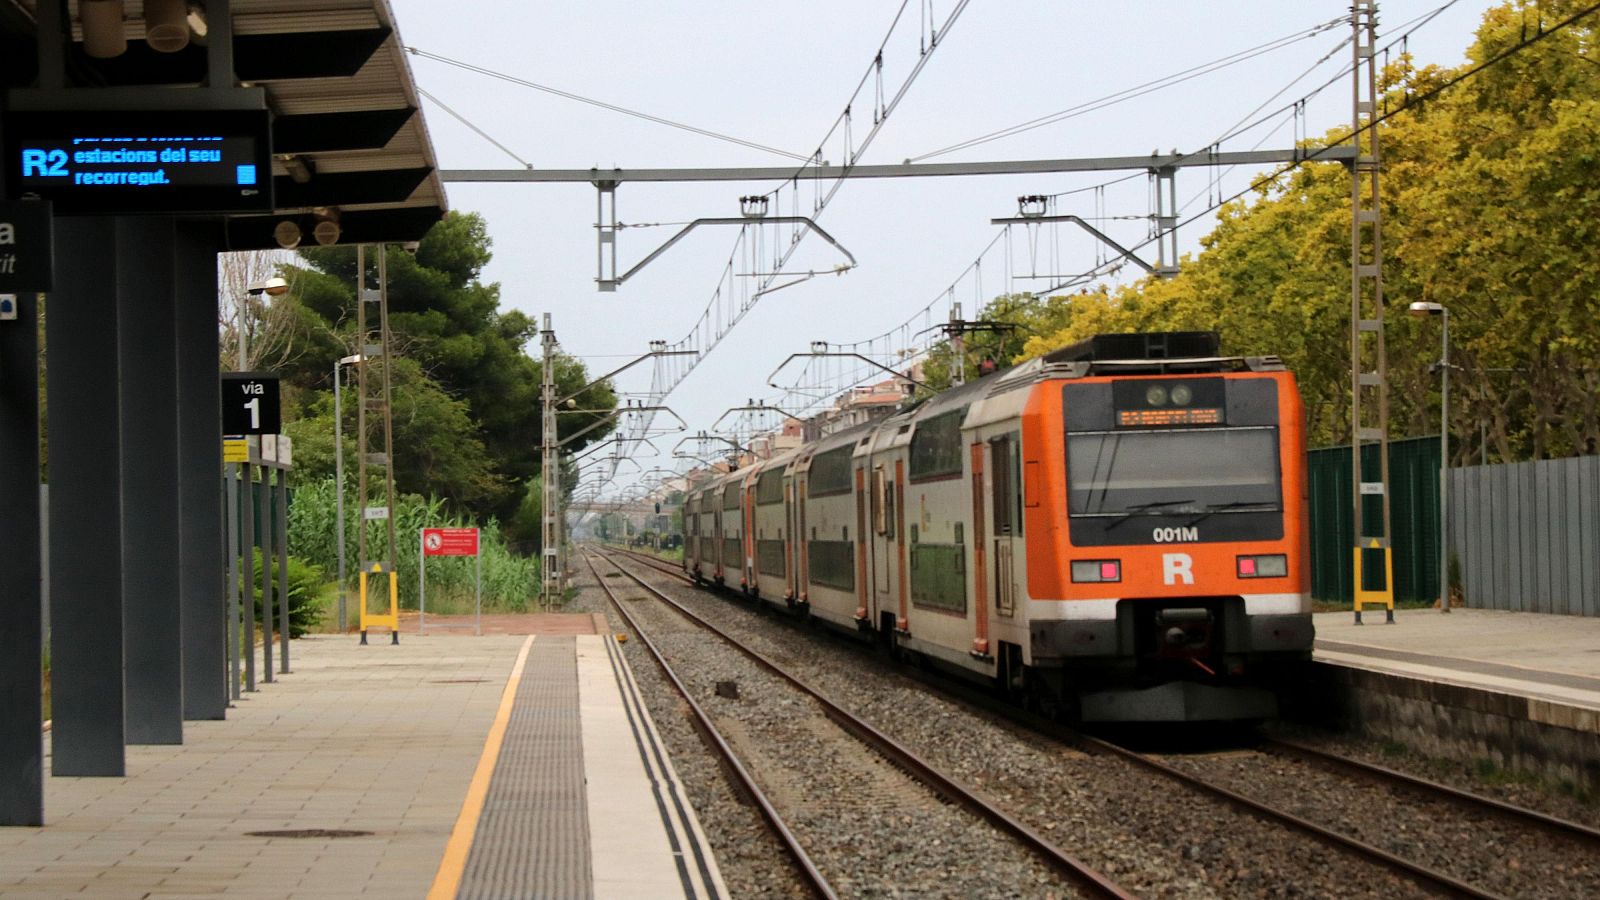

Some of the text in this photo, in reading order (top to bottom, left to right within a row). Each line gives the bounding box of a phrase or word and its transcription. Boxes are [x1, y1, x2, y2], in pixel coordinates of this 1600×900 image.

[22, 149, 69, 177] R2
[74, 148, 221, 163] estacions del seu
[74, 169, 170, 185] recorregut.
[241, 381, 264, 395] via
[243, 398, 260, 429] 1
[1153, 527, 1198, 542] 001M
[1162, 553, 1194, 585] R
